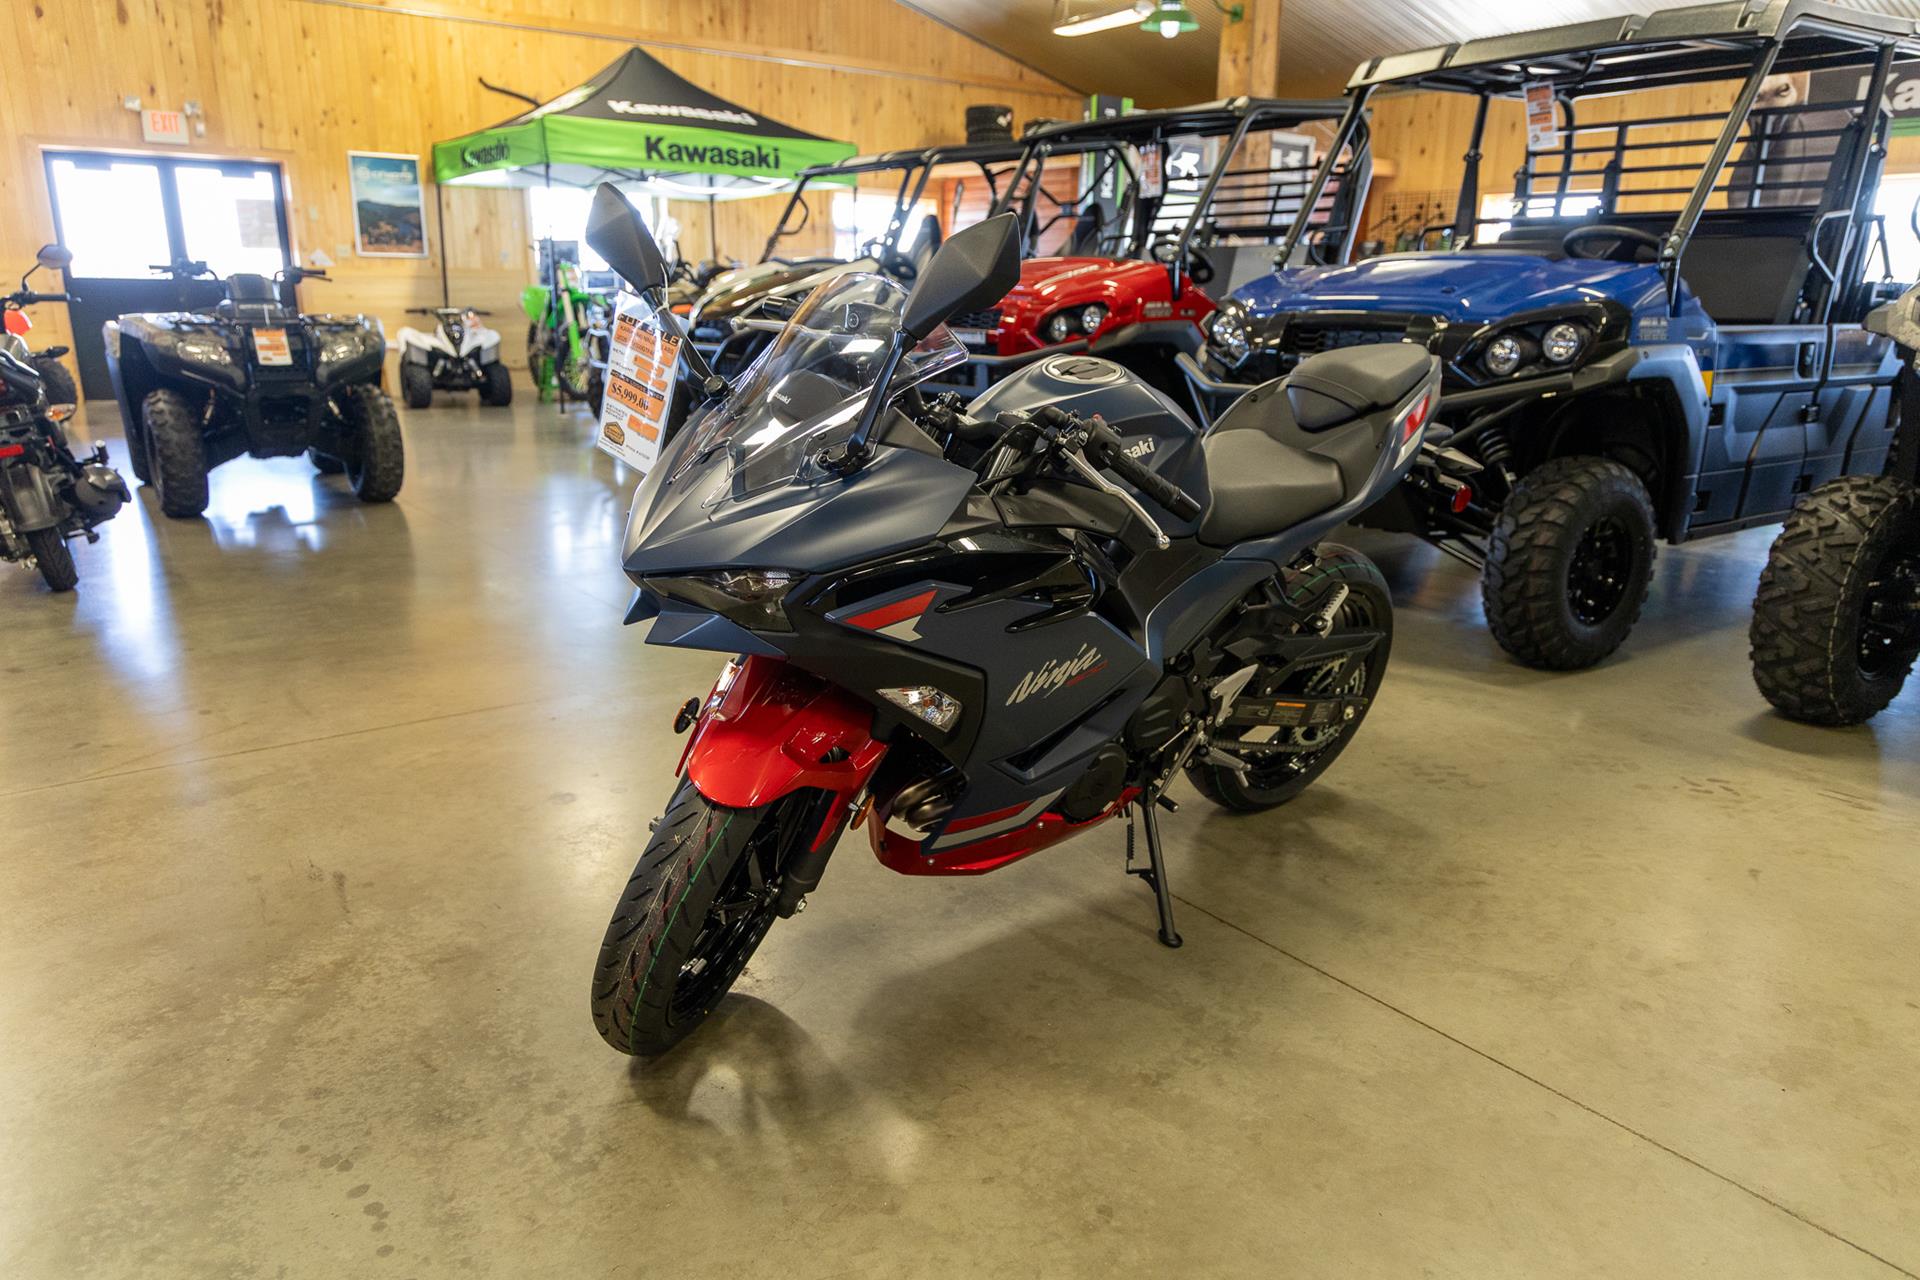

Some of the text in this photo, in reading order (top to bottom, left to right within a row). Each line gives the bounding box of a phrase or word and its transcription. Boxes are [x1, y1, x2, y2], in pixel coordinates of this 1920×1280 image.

[150, 111, 180, 134] EXIT
[645, 134, 780, 169] Kawasaki
[1005, 643, 1102, 706] Ninja
